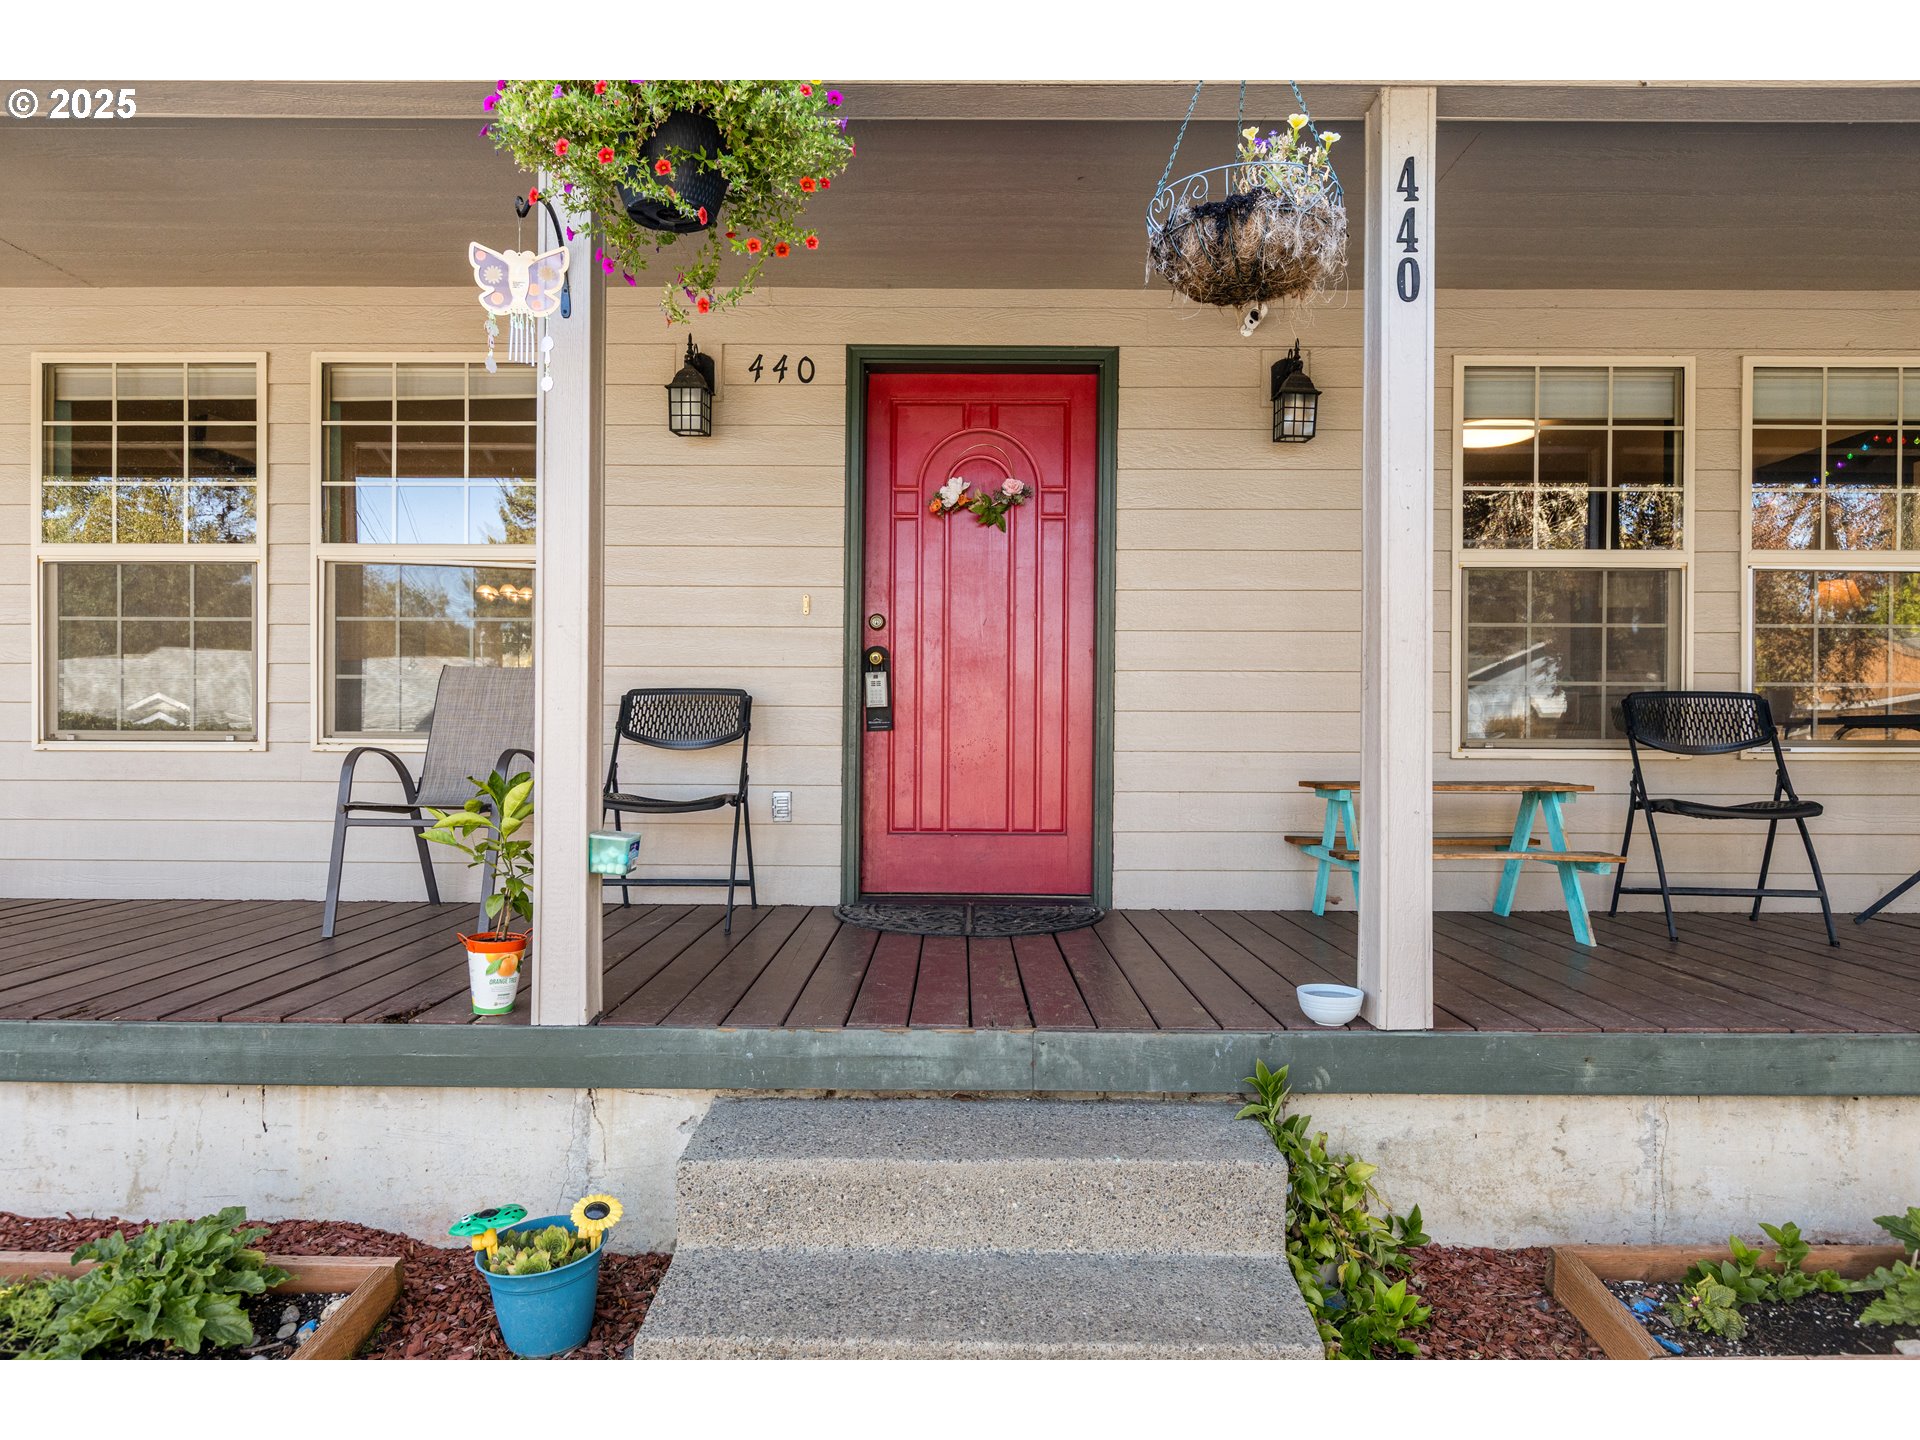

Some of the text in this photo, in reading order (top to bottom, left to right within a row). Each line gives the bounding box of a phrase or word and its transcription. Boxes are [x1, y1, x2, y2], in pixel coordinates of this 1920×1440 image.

[1396, 156, 1421, 303] 440
[748, 353, 816, 384] 440
[489, 977, 508, 985] ORANGE
